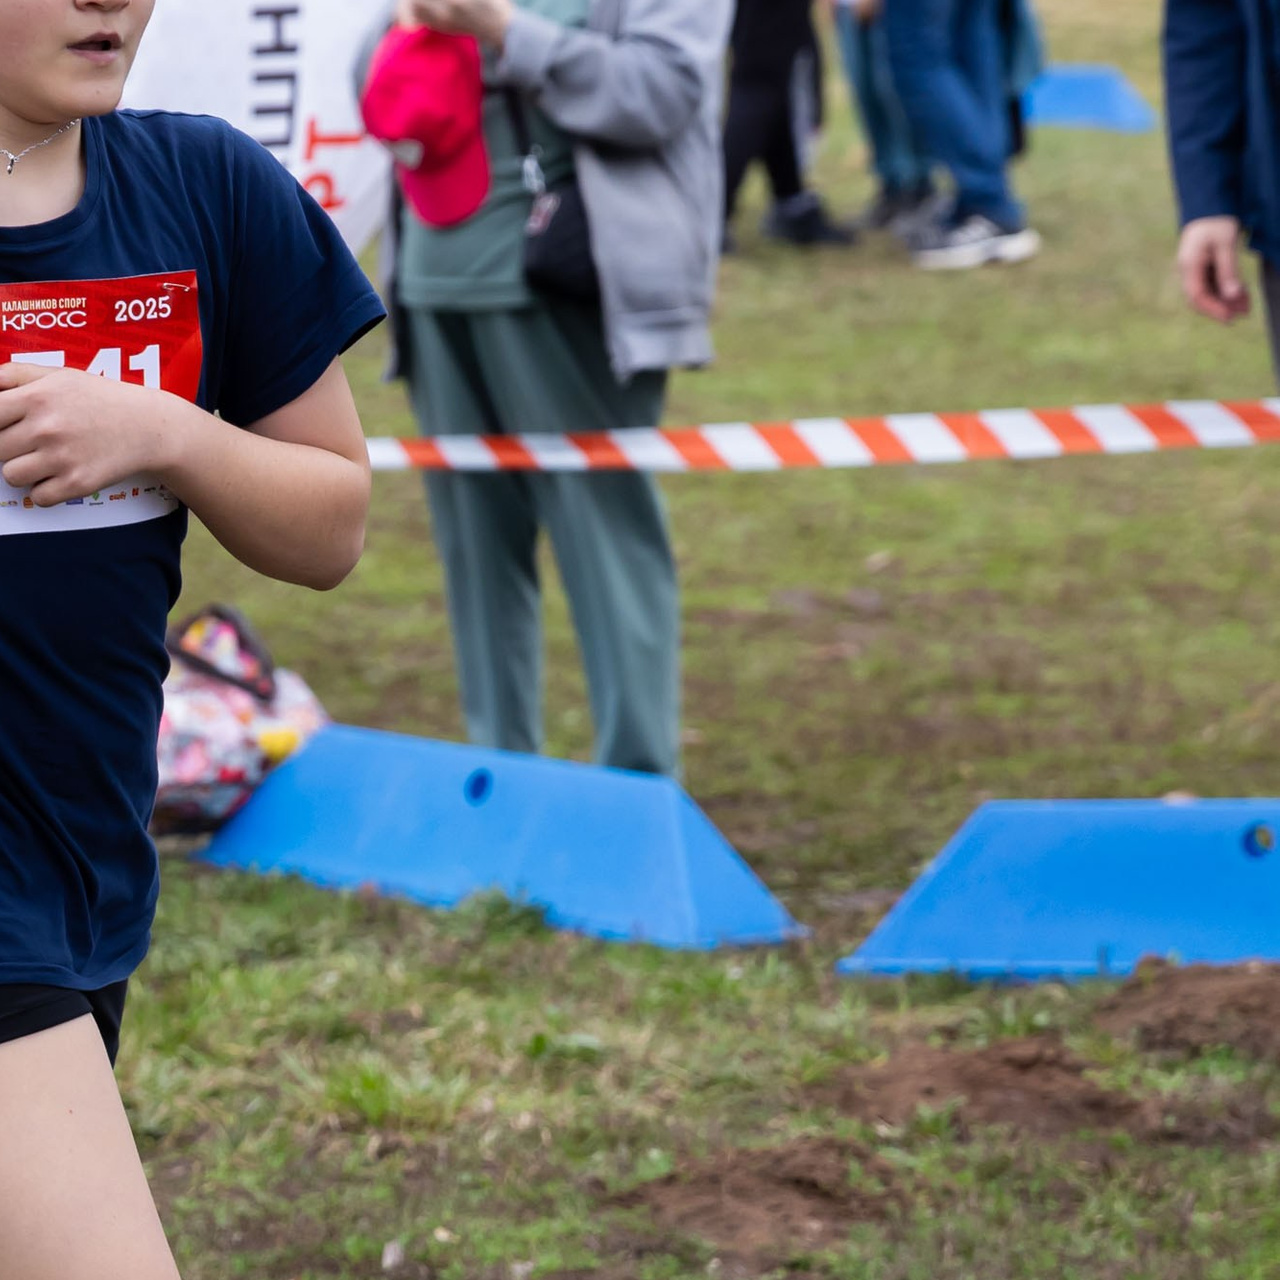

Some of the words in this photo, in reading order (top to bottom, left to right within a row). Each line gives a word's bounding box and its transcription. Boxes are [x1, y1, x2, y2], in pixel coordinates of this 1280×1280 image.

[1, 298, 57, 312] КАЛАШНИКОВ
[58, 297, 87, 310] СПОРТ
[114, 295, 172, 322] 2025
[2, 310, 87, 332] КРОСС
